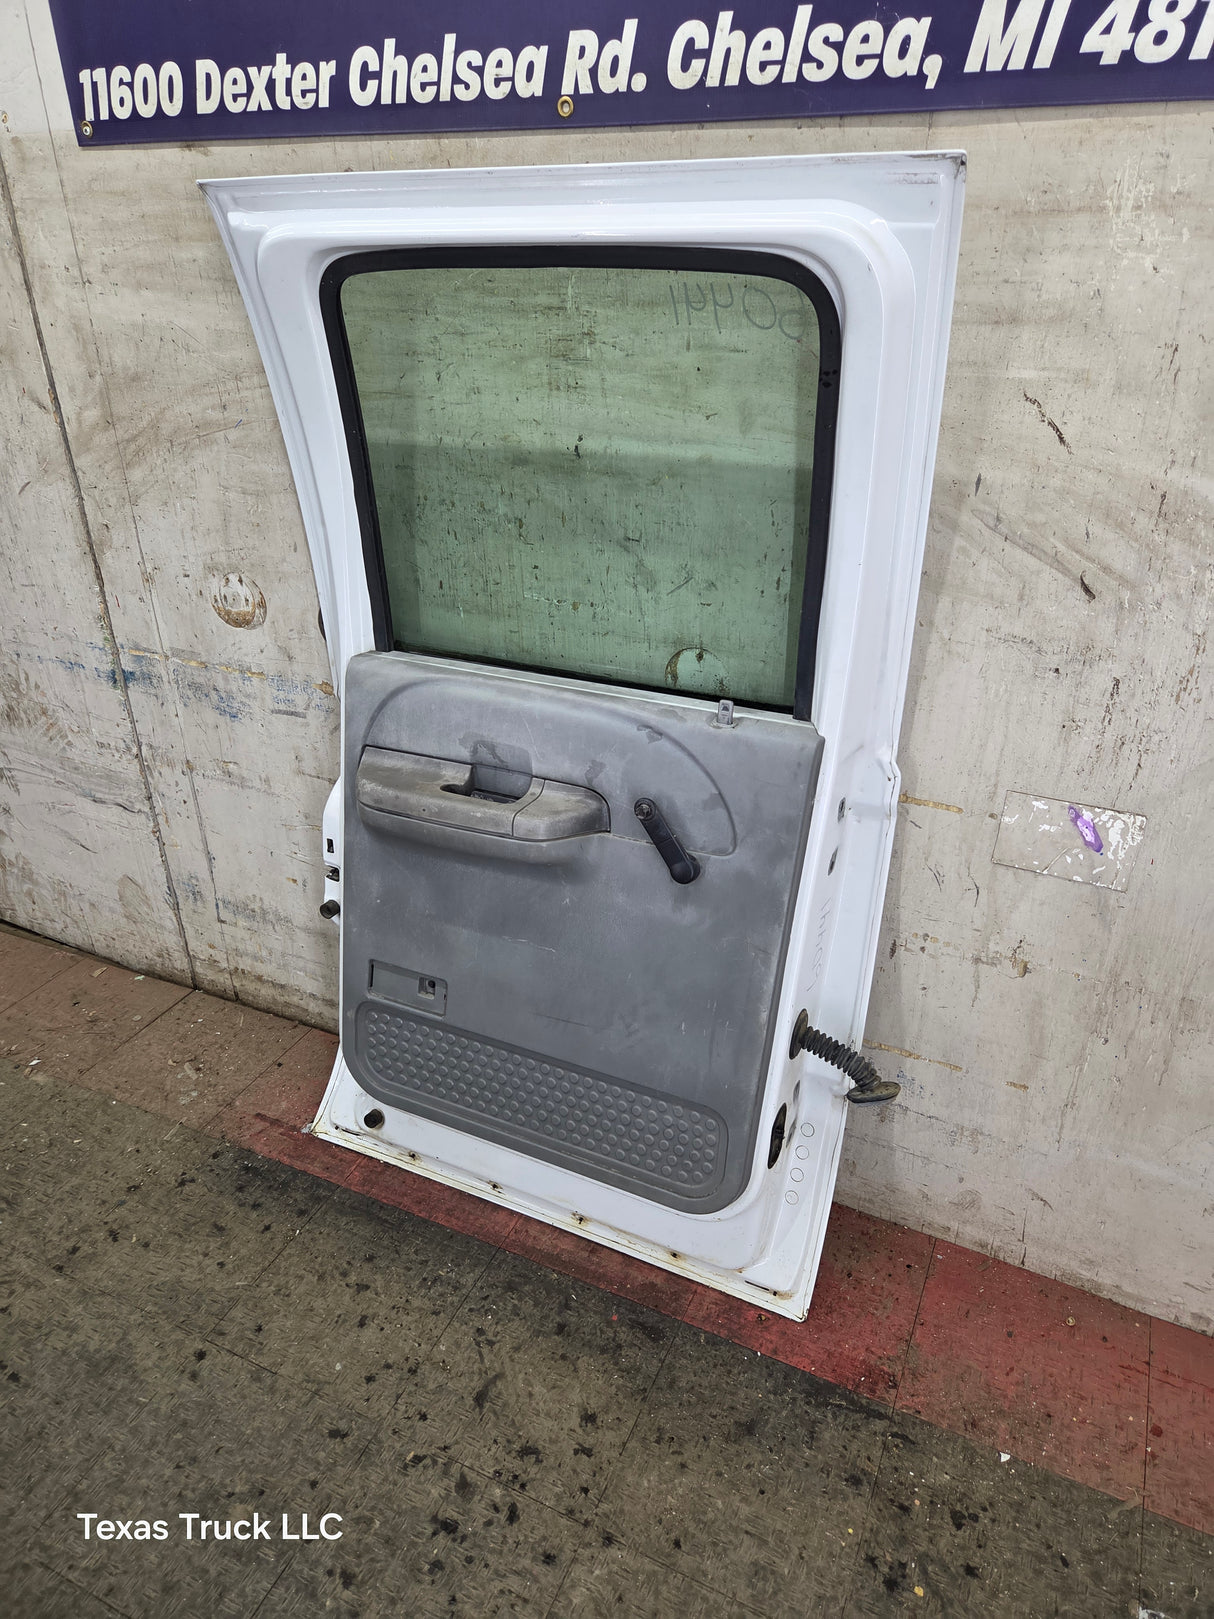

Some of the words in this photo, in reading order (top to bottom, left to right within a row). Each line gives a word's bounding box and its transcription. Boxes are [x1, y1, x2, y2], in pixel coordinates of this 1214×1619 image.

[79, 61, 183, 122] 11600
[195, 53, 336, 115] Dexter
[349, 33, 548, 106] Chelsea
[561, 19, 646, 95] Rd.
[667, 5, 942, 89] Chelsea,
[964, 0, 1071, 73] MI
